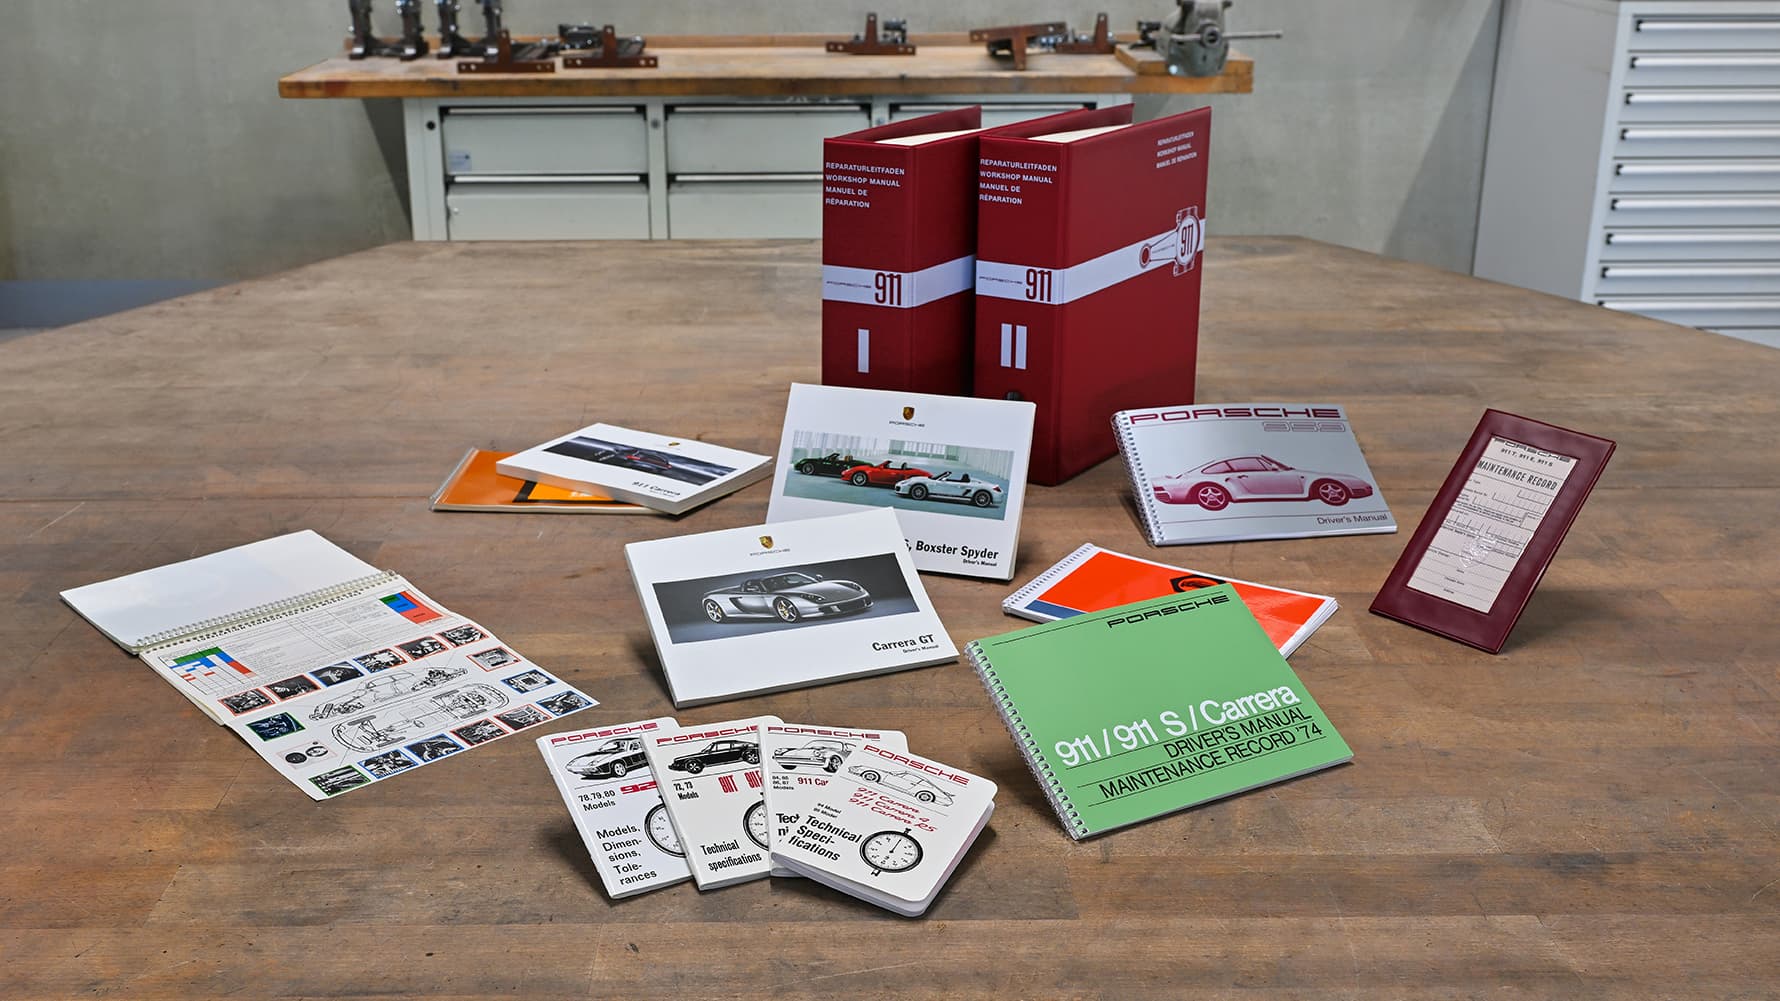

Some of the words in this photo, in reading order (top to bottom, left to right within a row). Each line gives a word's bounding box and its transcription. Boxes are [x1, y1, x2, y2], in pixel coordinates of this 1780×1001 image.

[825, 161, 905, 176] REPARATURLEITFADEN
[979, 158, 1058, 173] REPARATURLEITFADEN
[825, 174, 868, 184] WORKSHOP
[869, 178, 901, 187] MANUAL
[979, 170, 1021, 181] WORKSHOP
[1022, 174, 1053, 184] MANUAL
[825, 186, 856, 196] MANUEL
[857, 188, 868, 197] DE
[979, 182, 1009, 192] MANUEL
[1011, 185, 1021, 193] DE
[1180, 223, 1194, 257] 911
[874, 272, 902, 306] 911
[1025, 268, 1052, 302] 911
[1130, 407, 1341, 426] PORSCHE
[1477, 460, 1528, 482] MAINTENANCE
[1526, 474, 1559, 491] RECORD
[649, 485, 681, 496] Carrera
[1316, 515, 1352, 525] Driver's
[1353, 513, 1388, 523] Manual
[916, 540, 958, 555] Boxster
[960, 545, 999, 560] Spyder
[1106, 594, 1231, 629] PORSCHE
[871, 639, 917, 652] Carrera
[918, 633, 935, 645] GT
[551, 722, 658, 745] PORSCHE
[767, 726, 881, 740] PORSCHE
[1054, 734, 1102, 767] 911
[1102, 728, 1111, 756] /
[1113, 718, 1159, 751] 911
[1159, 710, 1187, 737] S
[1188, 704, 1198, 731] /
[1199, 685, 1301, 725] Carrera
[1163, 725, 1241, 759] DRIVER'S
[1239, 707, 1313, 737] MANUAL
[863, 744, 970, 786] PORSCHE
[1098, 749, 1227, 799] MAINTENANCE
[1224, 729, 1297, 762] RECORD
[1295, 722, 1323, 740] '74
[797, 776, 813, 785] 911
[677, 790, 699, 801] Models
[857, 787, 878, 796] 911
[879, 795, 920, 814] Carrera
[582, 799, 617, 812] Models
[848, 798, 869, 807] 911
[870, 806, 912, 825] Carrera
[913, 823, 939, 832] RS
[853, 792, 874, 802] 911
[874, 801, 916, 819] Carrera
[796, 825, 836, 845] Speci-
[805, 814, 863, 844] Technical
[601, 837, 642, 852] Dimen-
[700, 839, 740, 856] Technical
[788, 835, 841, 861] fications
[613, 862, 642, 875] Tole-
[707, 851, 763, 872] specifications
[619, 870, 658, 885] rances
